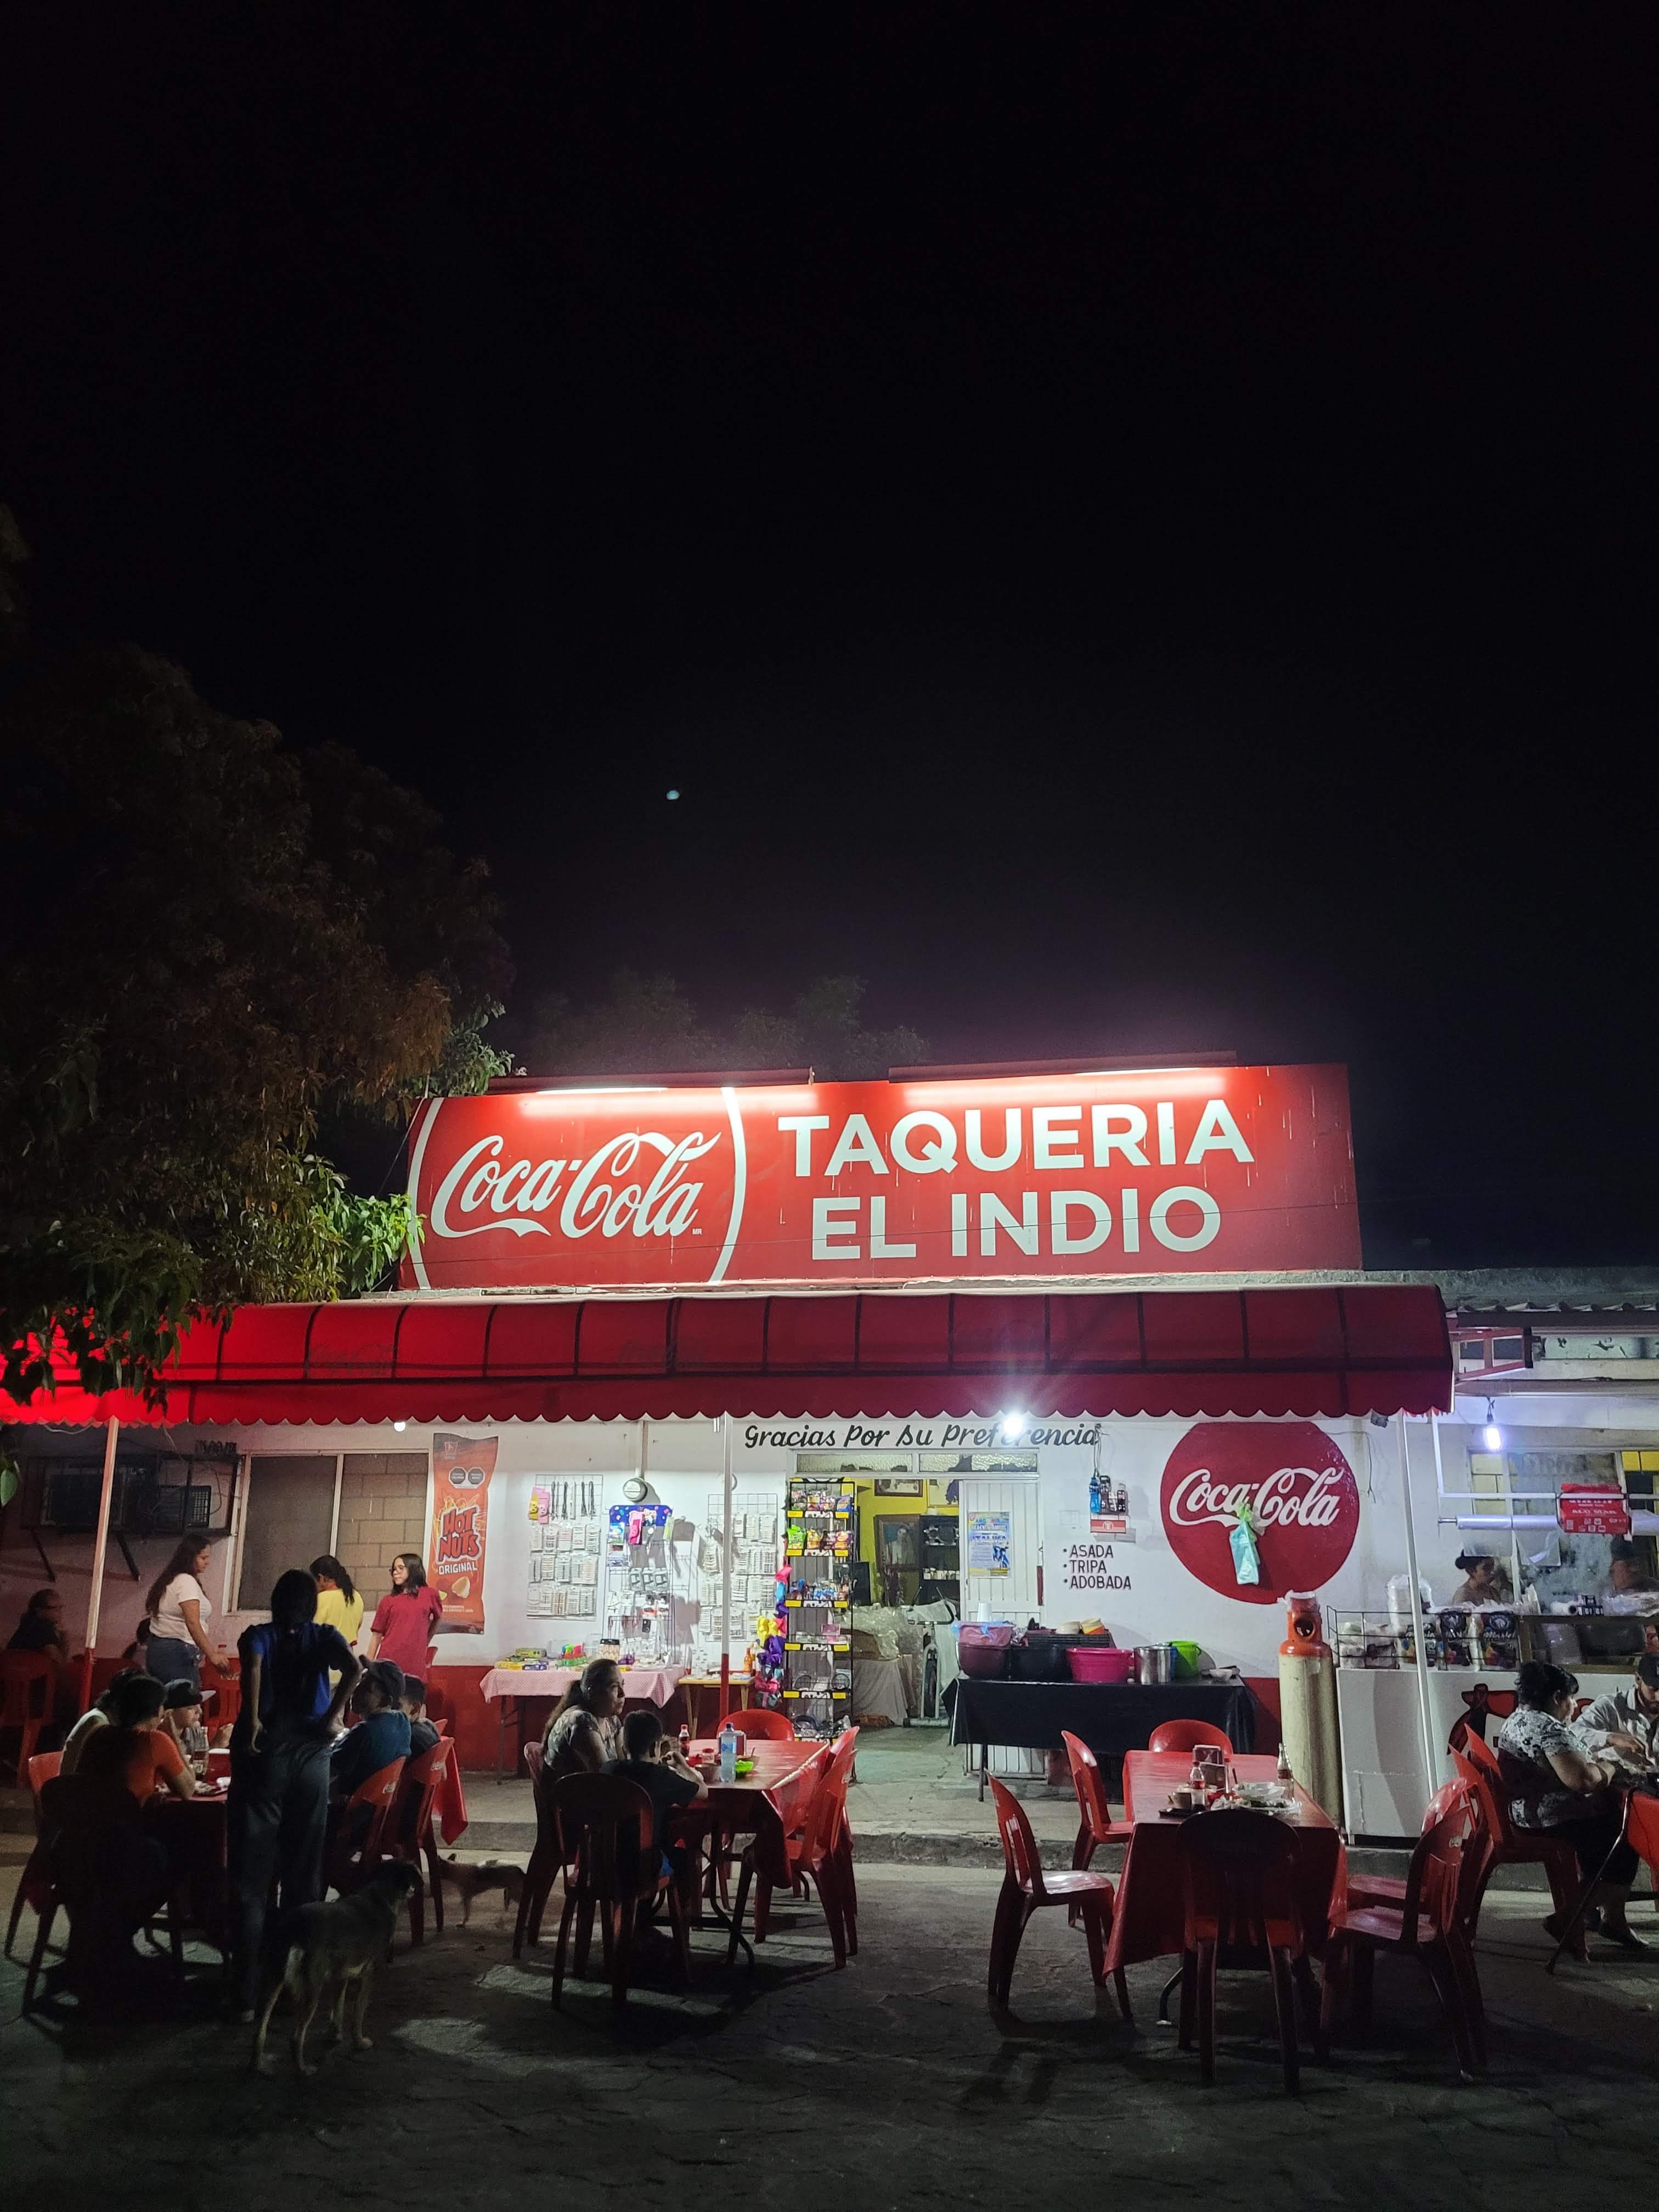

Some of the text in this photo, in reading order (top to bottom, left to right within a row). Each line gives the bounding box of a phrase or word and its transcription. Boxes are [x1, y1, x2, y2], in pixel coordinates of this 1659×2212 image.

[778, 1099, 1255, 1177] TAQUERIA
[431, 1131, 722, 1238] Coca-Cola
[812, 1186, 1221, 1260] EL INDIO
[744, 1424, 836, 1449] Gracias
[843, 1424, 890, 1448] Por
[895, 1424, 933, 1447] Su
[1169, 1467, 1344, 1528] Coca-Cola
[443, 1507, 477, 1536] HOT
[438, 1529, 479, 1562] NUTS
[1069, 1544, 1114, 1559] ASADA
[439, 1561, 478, 1575] ORIGINAL
[1069, 1559, 1107, 1574] TRIPA
[1070, 1575, 1131, 1590] ADOBADA
